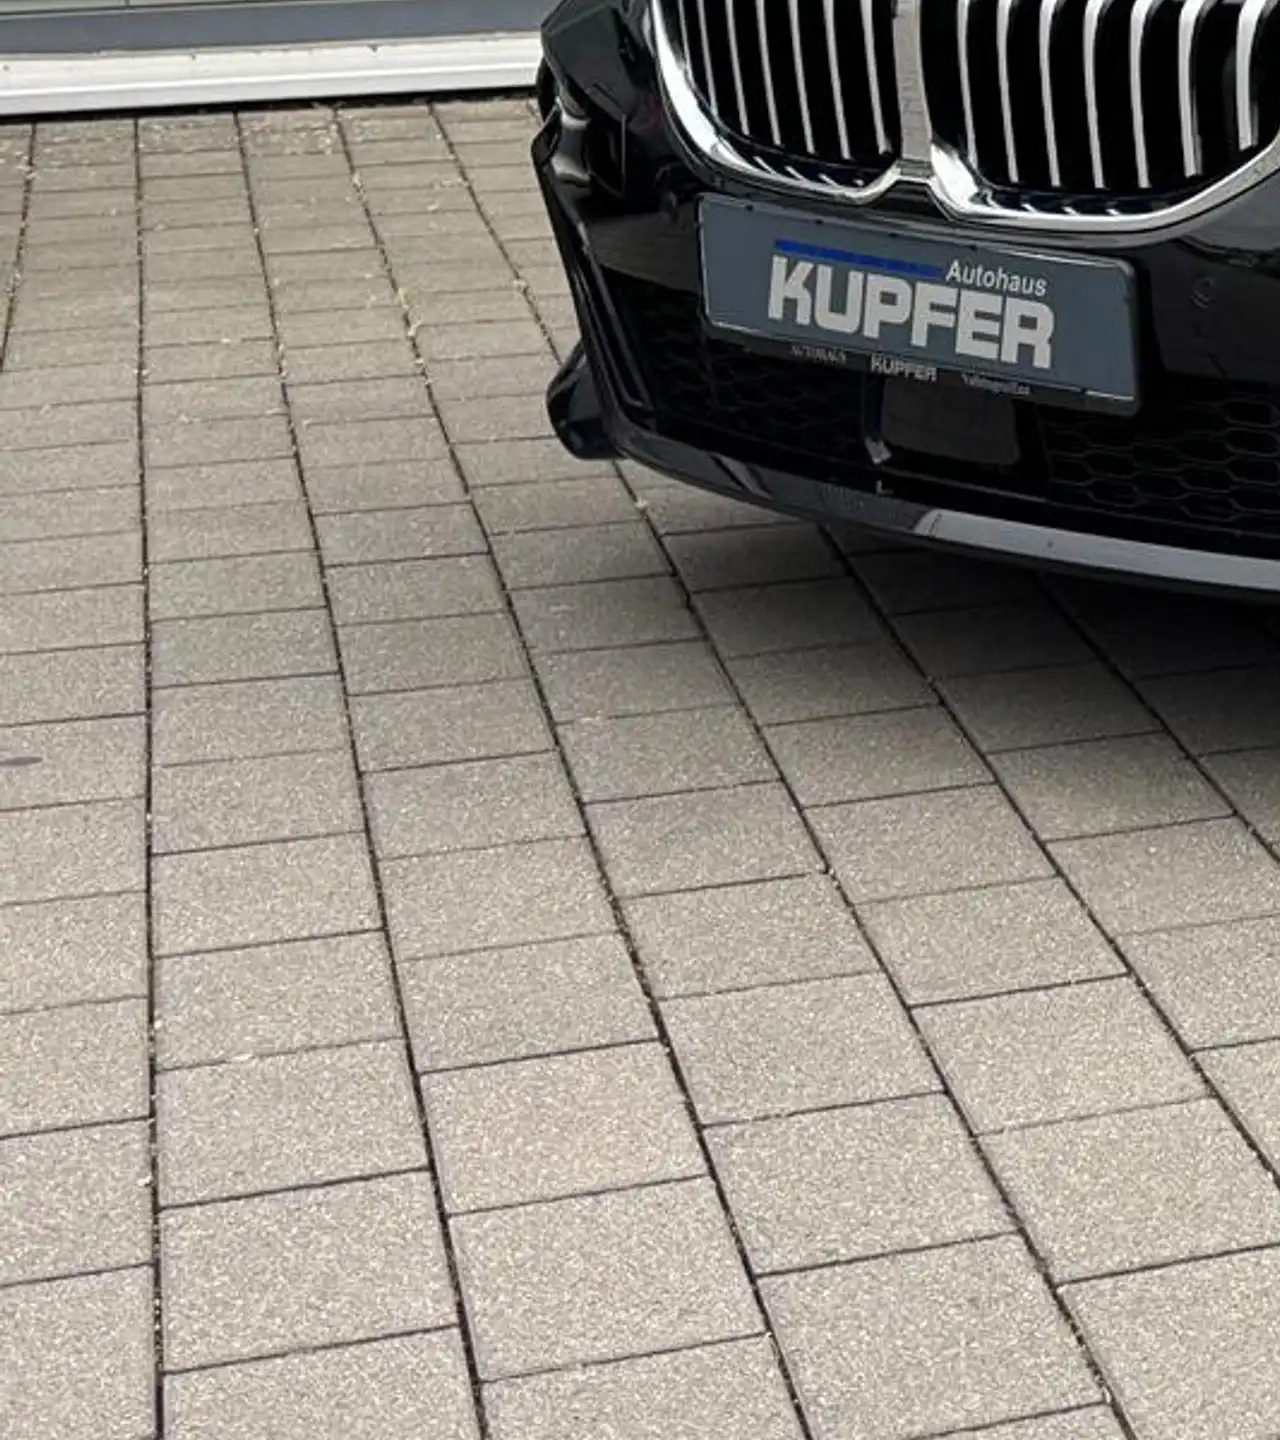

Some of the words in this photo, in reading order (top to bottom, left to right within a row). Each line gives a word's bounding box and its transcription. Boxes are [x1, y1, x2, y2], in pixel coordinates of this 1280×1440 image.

[945, 259, 1048, 297] Autohaus
[767, 254, 1056, 370] KUPFER
[869, 352, 938, 383] KUPFER
